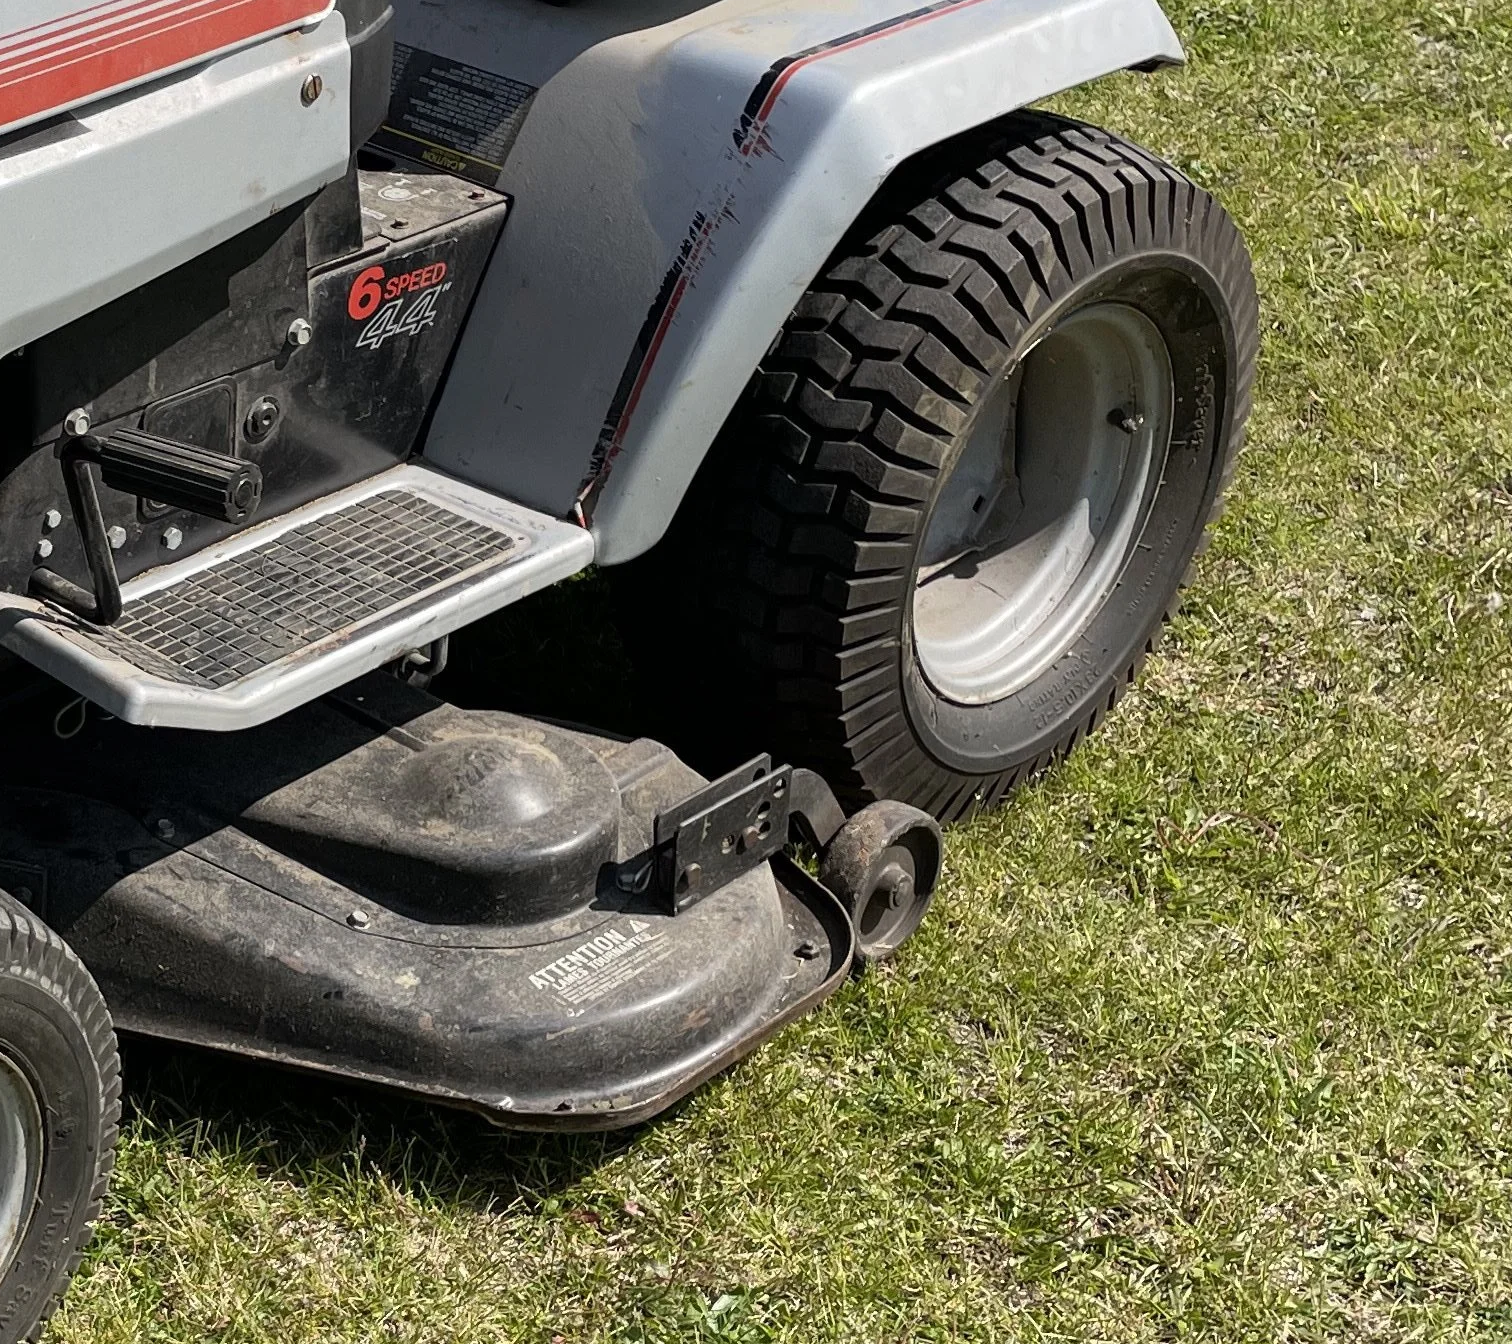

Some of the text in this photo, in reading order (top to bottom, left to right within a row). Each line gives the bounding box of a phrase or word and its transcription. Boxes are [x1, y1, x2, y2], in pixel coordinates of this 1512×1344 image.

[348, 262, 447, 320] 6 SPEED
[528, 928, 627, 990] ATTENTION
[552, 967, 589, 990] LAMES
